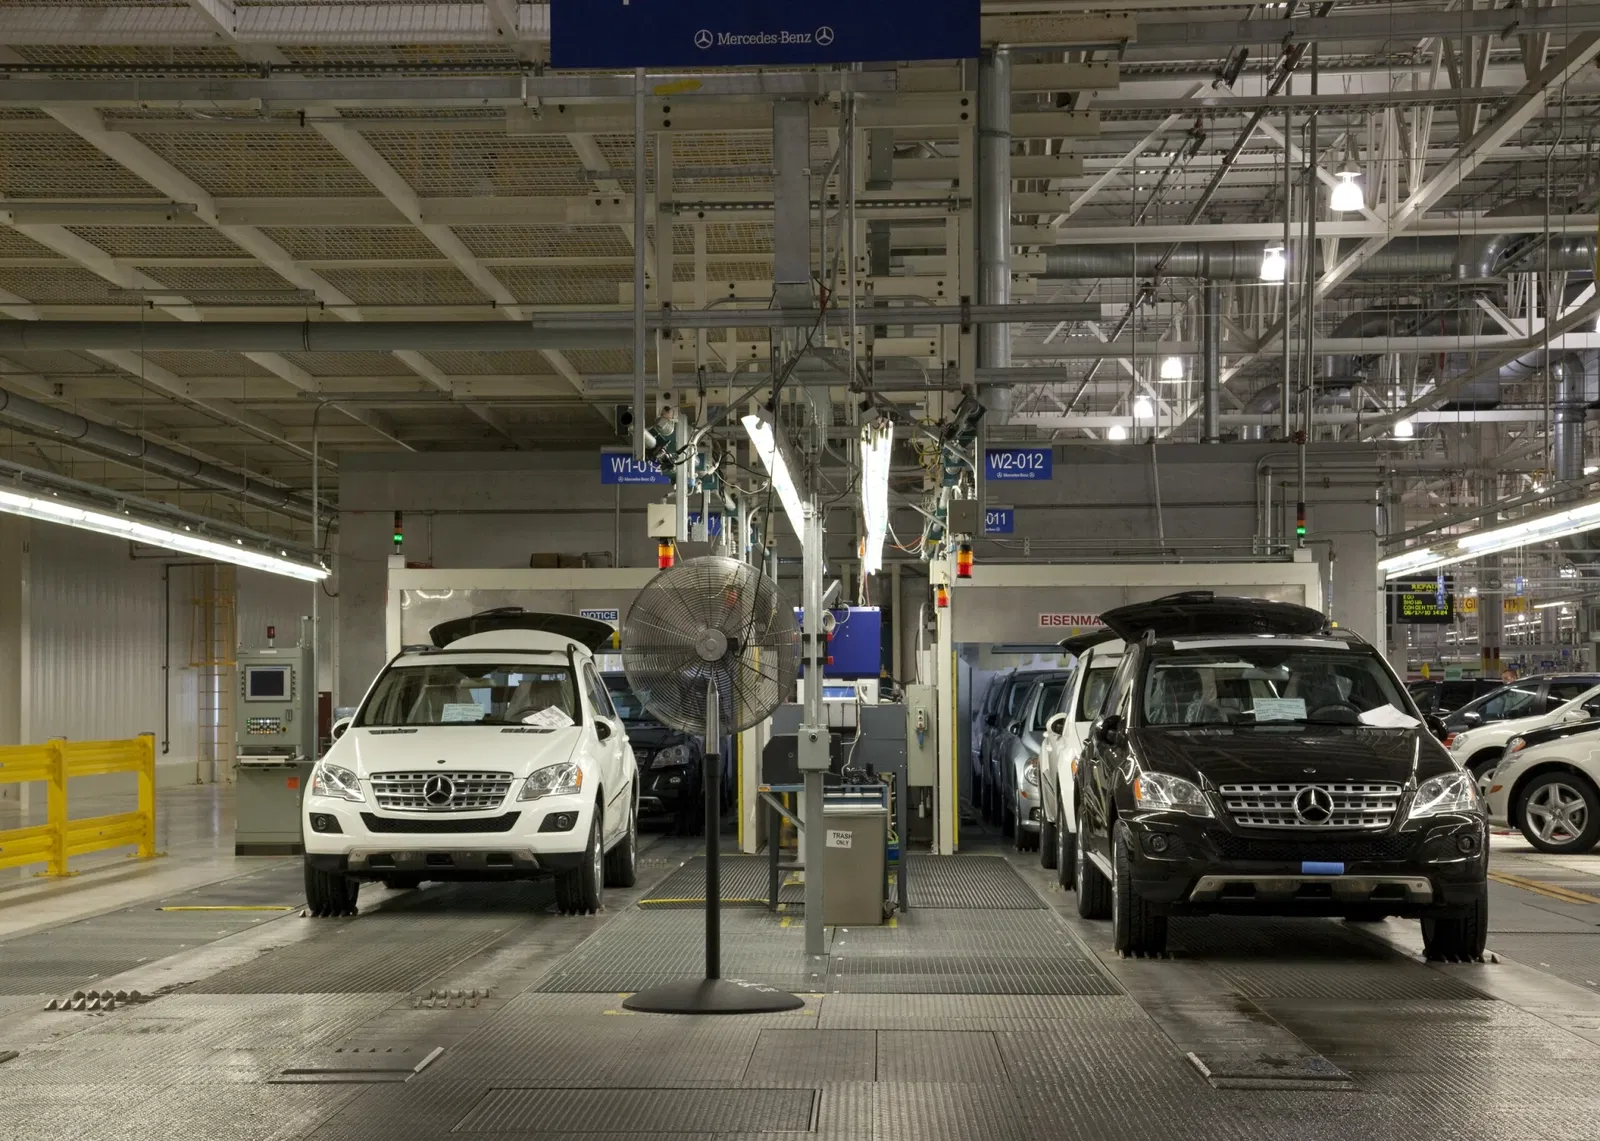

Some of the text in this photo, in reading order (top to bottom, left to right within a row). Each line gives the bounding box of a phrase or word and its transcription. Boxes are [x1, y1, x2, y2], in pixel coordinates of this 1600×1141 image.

[717, 31, 812, 45] Mercedes-Benz
[990, 453, 1044, 469] W2-012
[582, 611, 616, 620] NOTICE
[1041, 615, 1104, 626] EISENMA
[832, 832, 852, 840] TRASH
